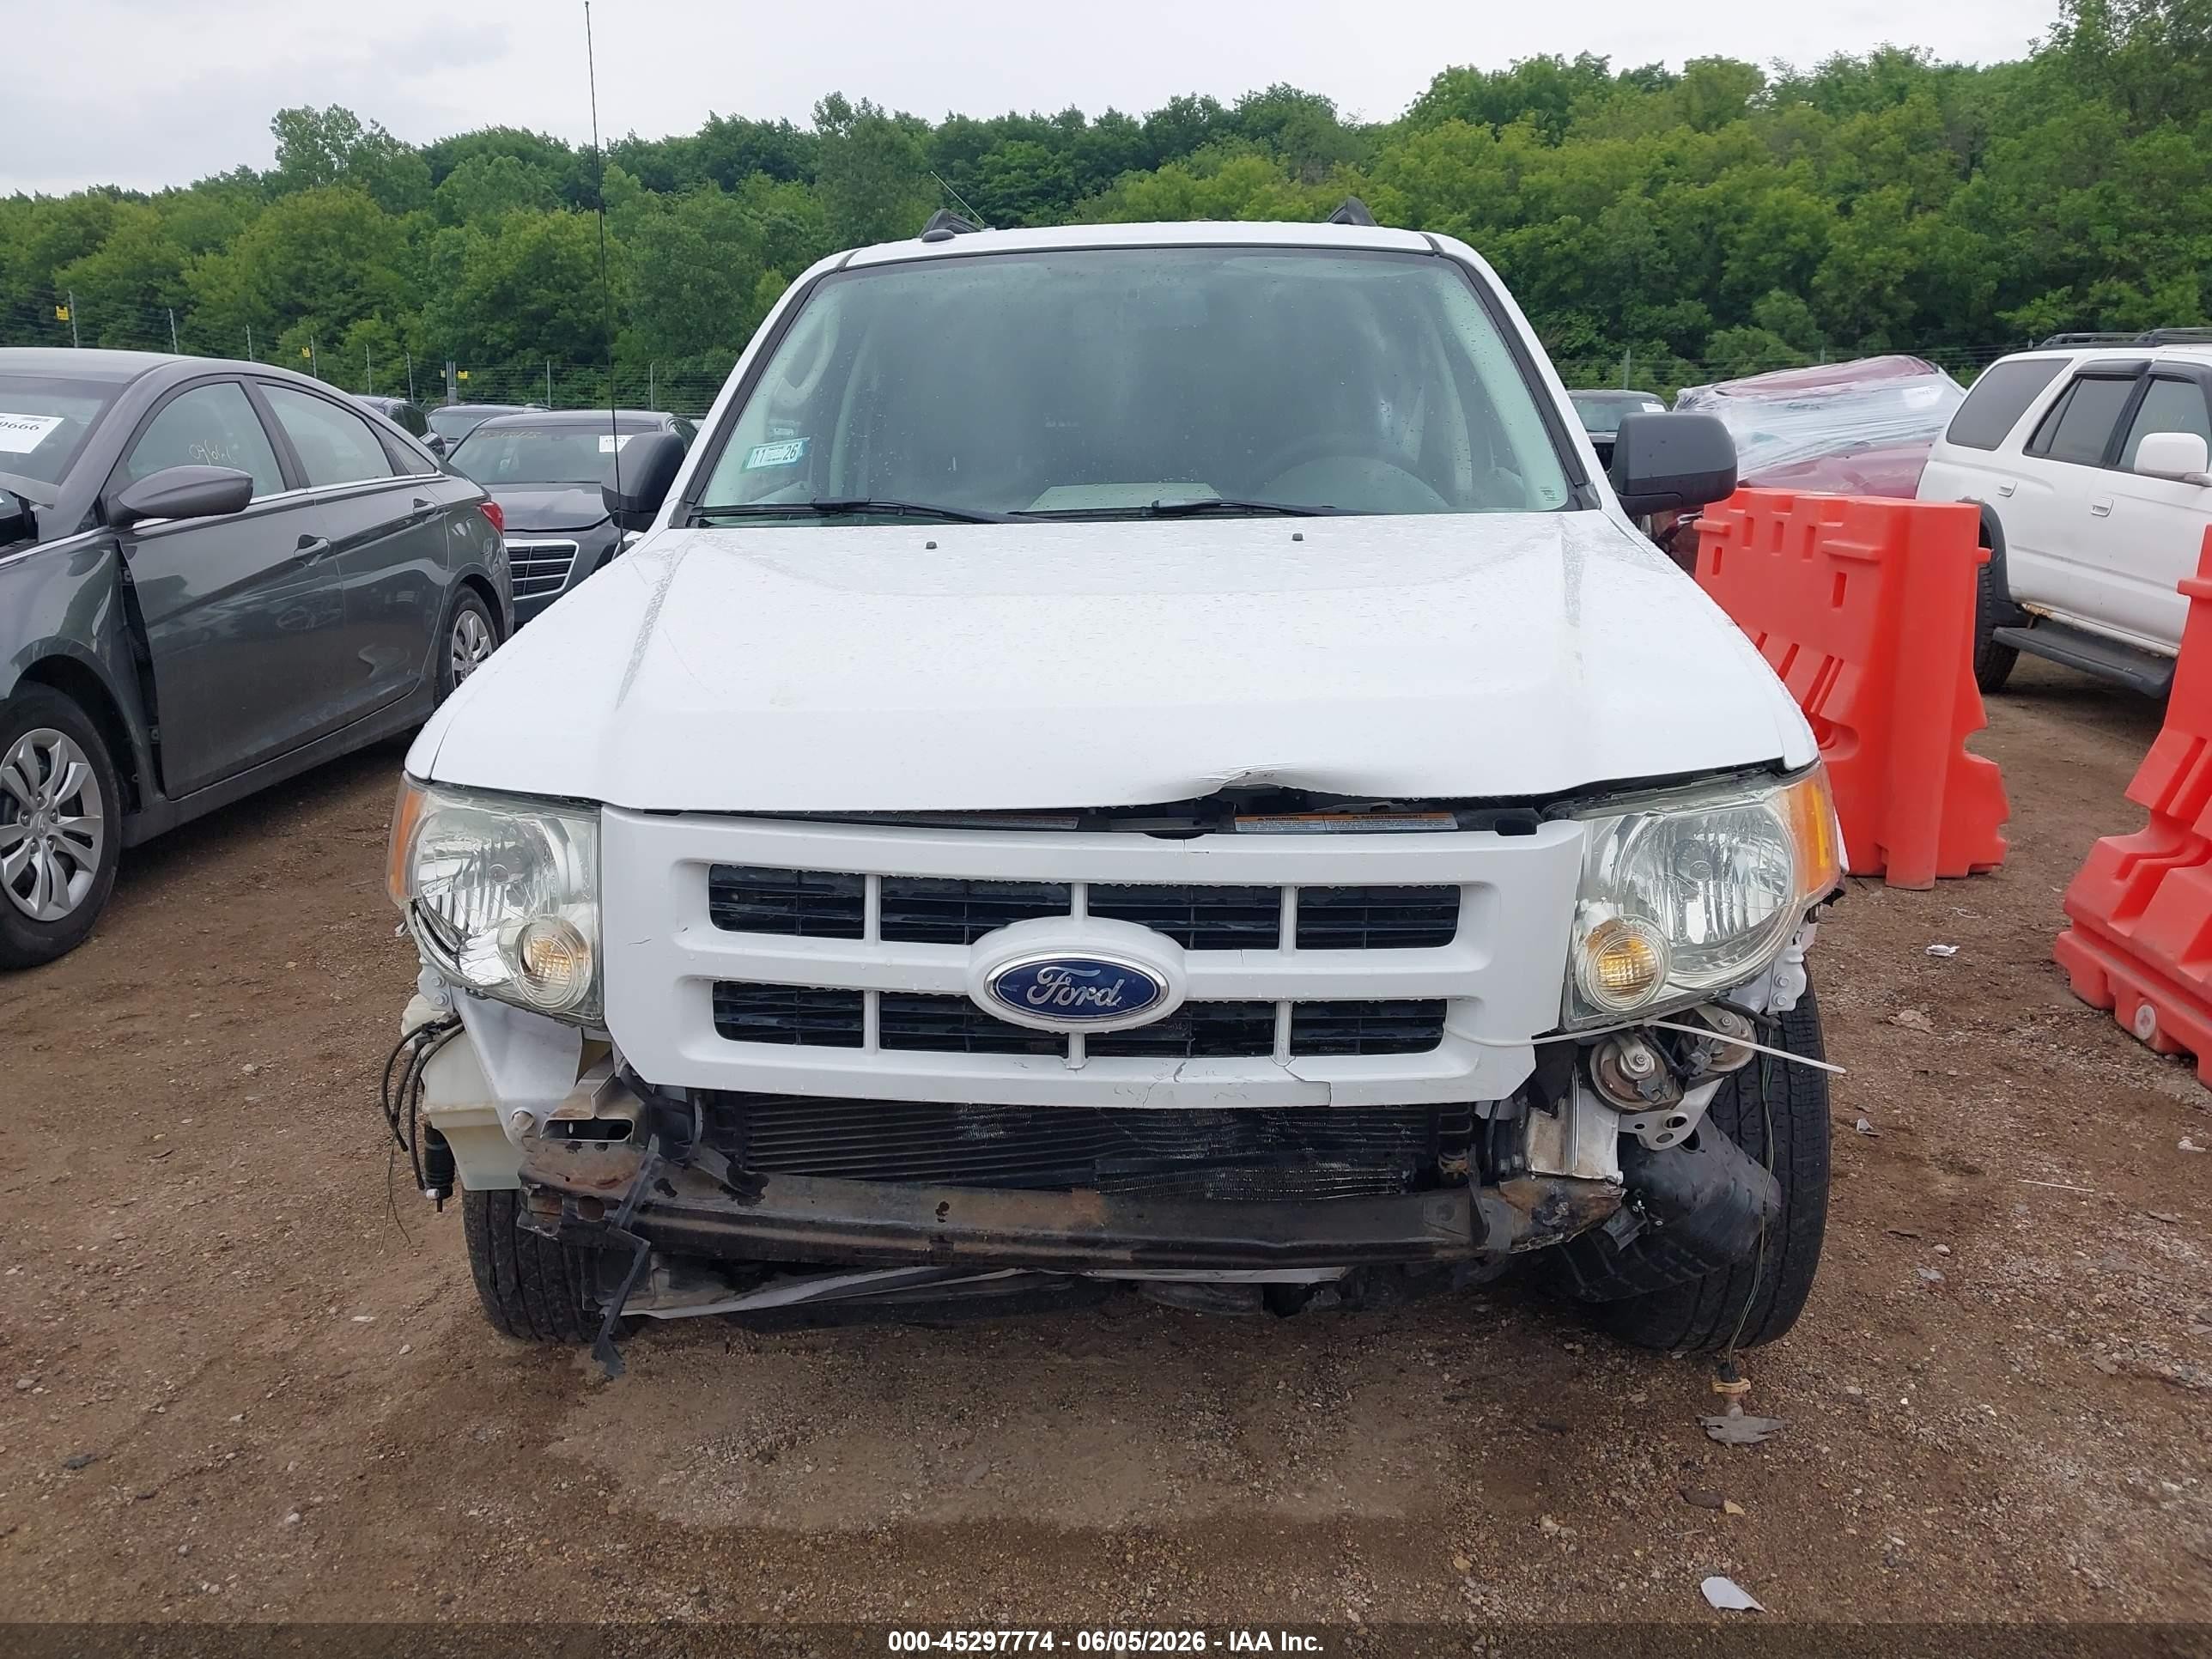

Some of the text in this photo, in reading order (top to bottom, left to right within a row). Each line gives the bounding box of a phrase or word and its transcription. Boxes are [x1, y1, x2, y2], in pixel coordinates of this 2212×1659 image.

[752, 443, 799, 466] 11 26
[1026, 966, 1126, 1007] Ford
